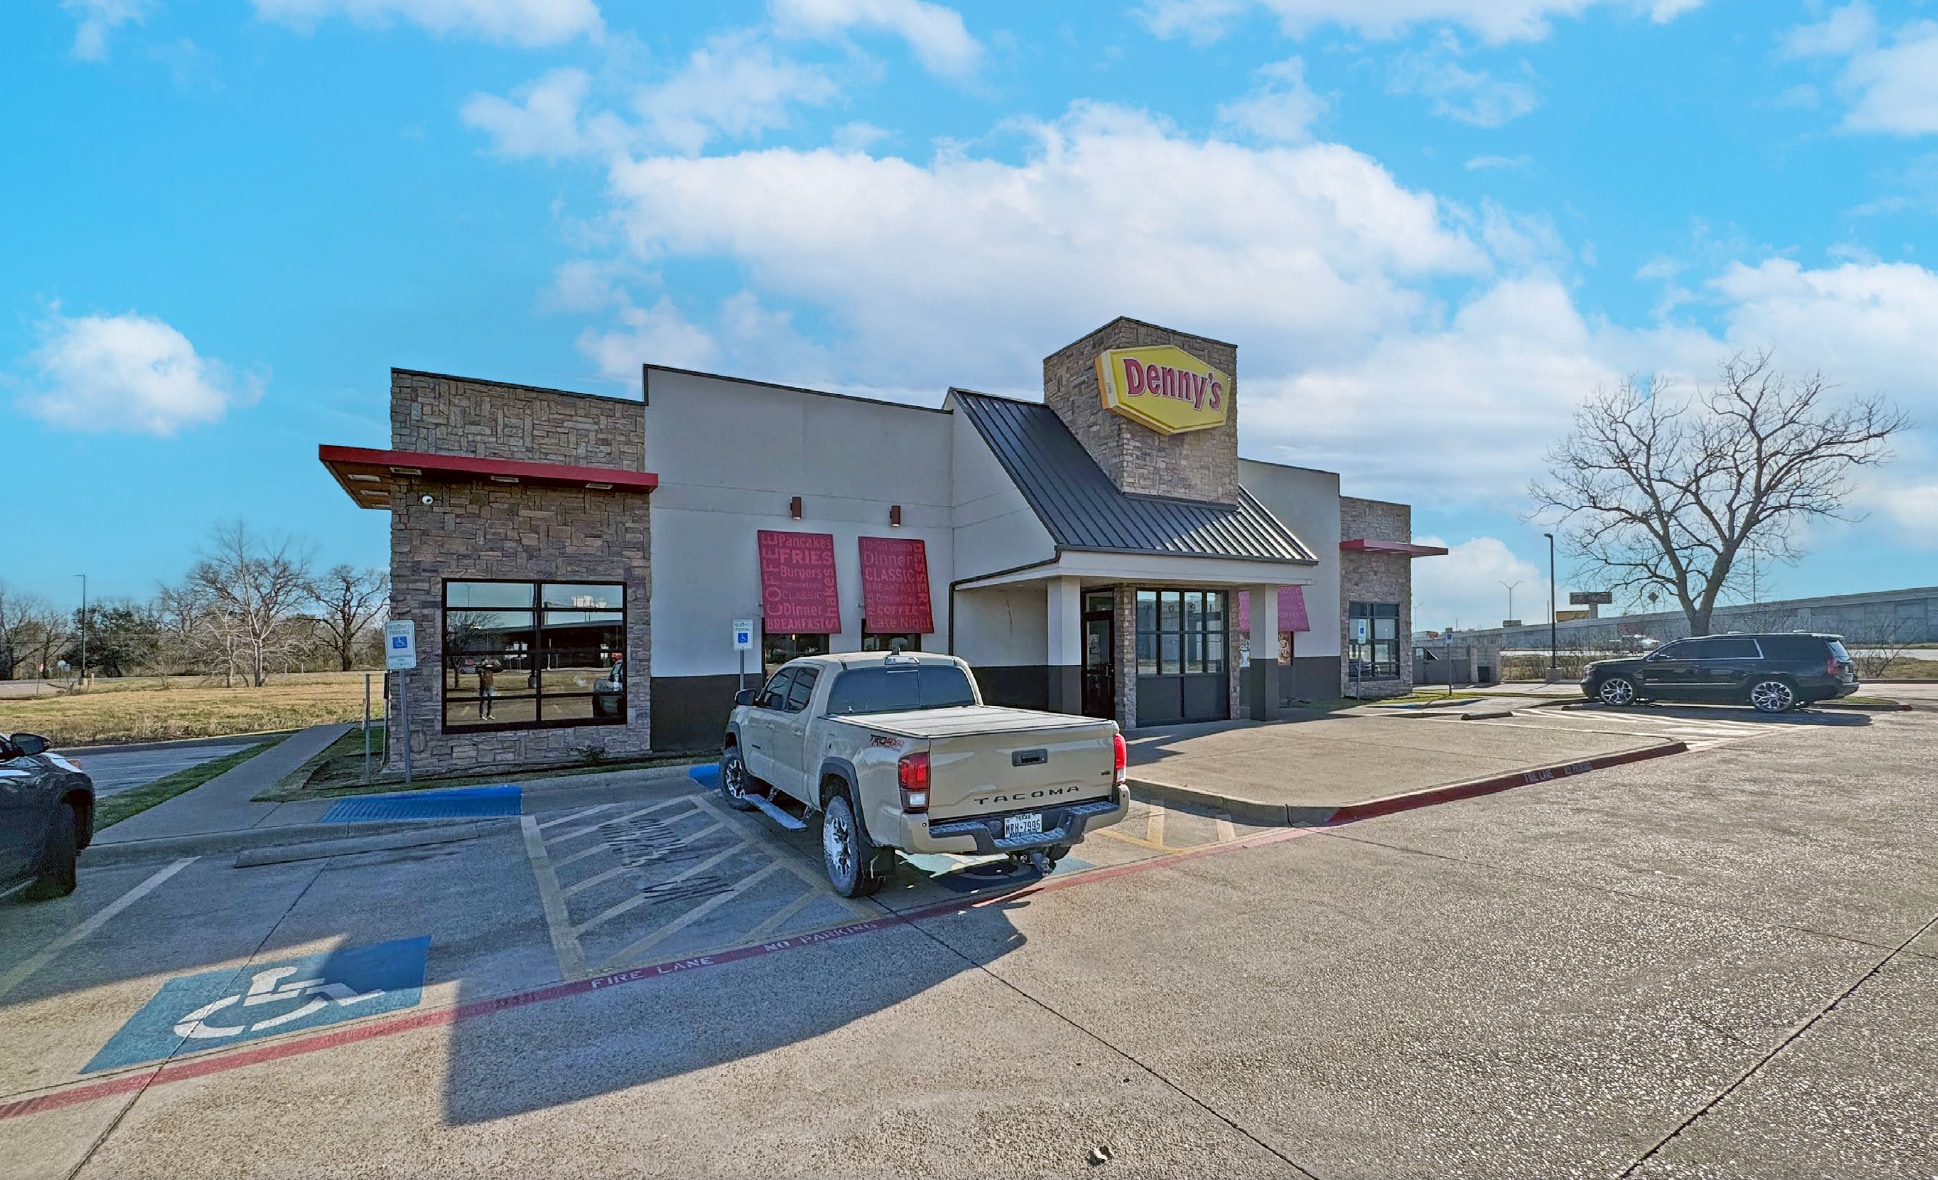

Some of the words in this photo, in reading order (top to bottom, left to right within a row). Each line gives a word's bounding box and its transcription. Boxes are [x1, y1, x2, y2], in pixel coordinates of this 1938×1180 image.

[1123, 358, 1223, 411] Denny's
[780, 535, 832, 549] Pancakes
[780, 548, 833, 565] FRIES
[863, 551, 912, 566] Dinner
[761, 533, 783, 615] COFFEE
[780, 565, 822, 579] Burgers
[865, 568, 914, 583] CLASSIC
[866, 583, 915, 593] BREAKFAST
[782, 591, 823, 601] CLASSIC
[823, 568, 839, 629] Shakes
[783, 602, 823, 616] Dinner
[877, 605, 919, 615] COFFEE
[767, 618, 824, 630] BREAKFAST
[870, 616, 896, 628] Late
[900, 617, 931, 630] Night
[974, 785, 1080, 805] TACOMA
[591, 969, 645, 989] FIRE
[657, 956, 714, 975] LANE
[762, 940, 790, 952] NO
[800, 921, 878, 944] PARKING
